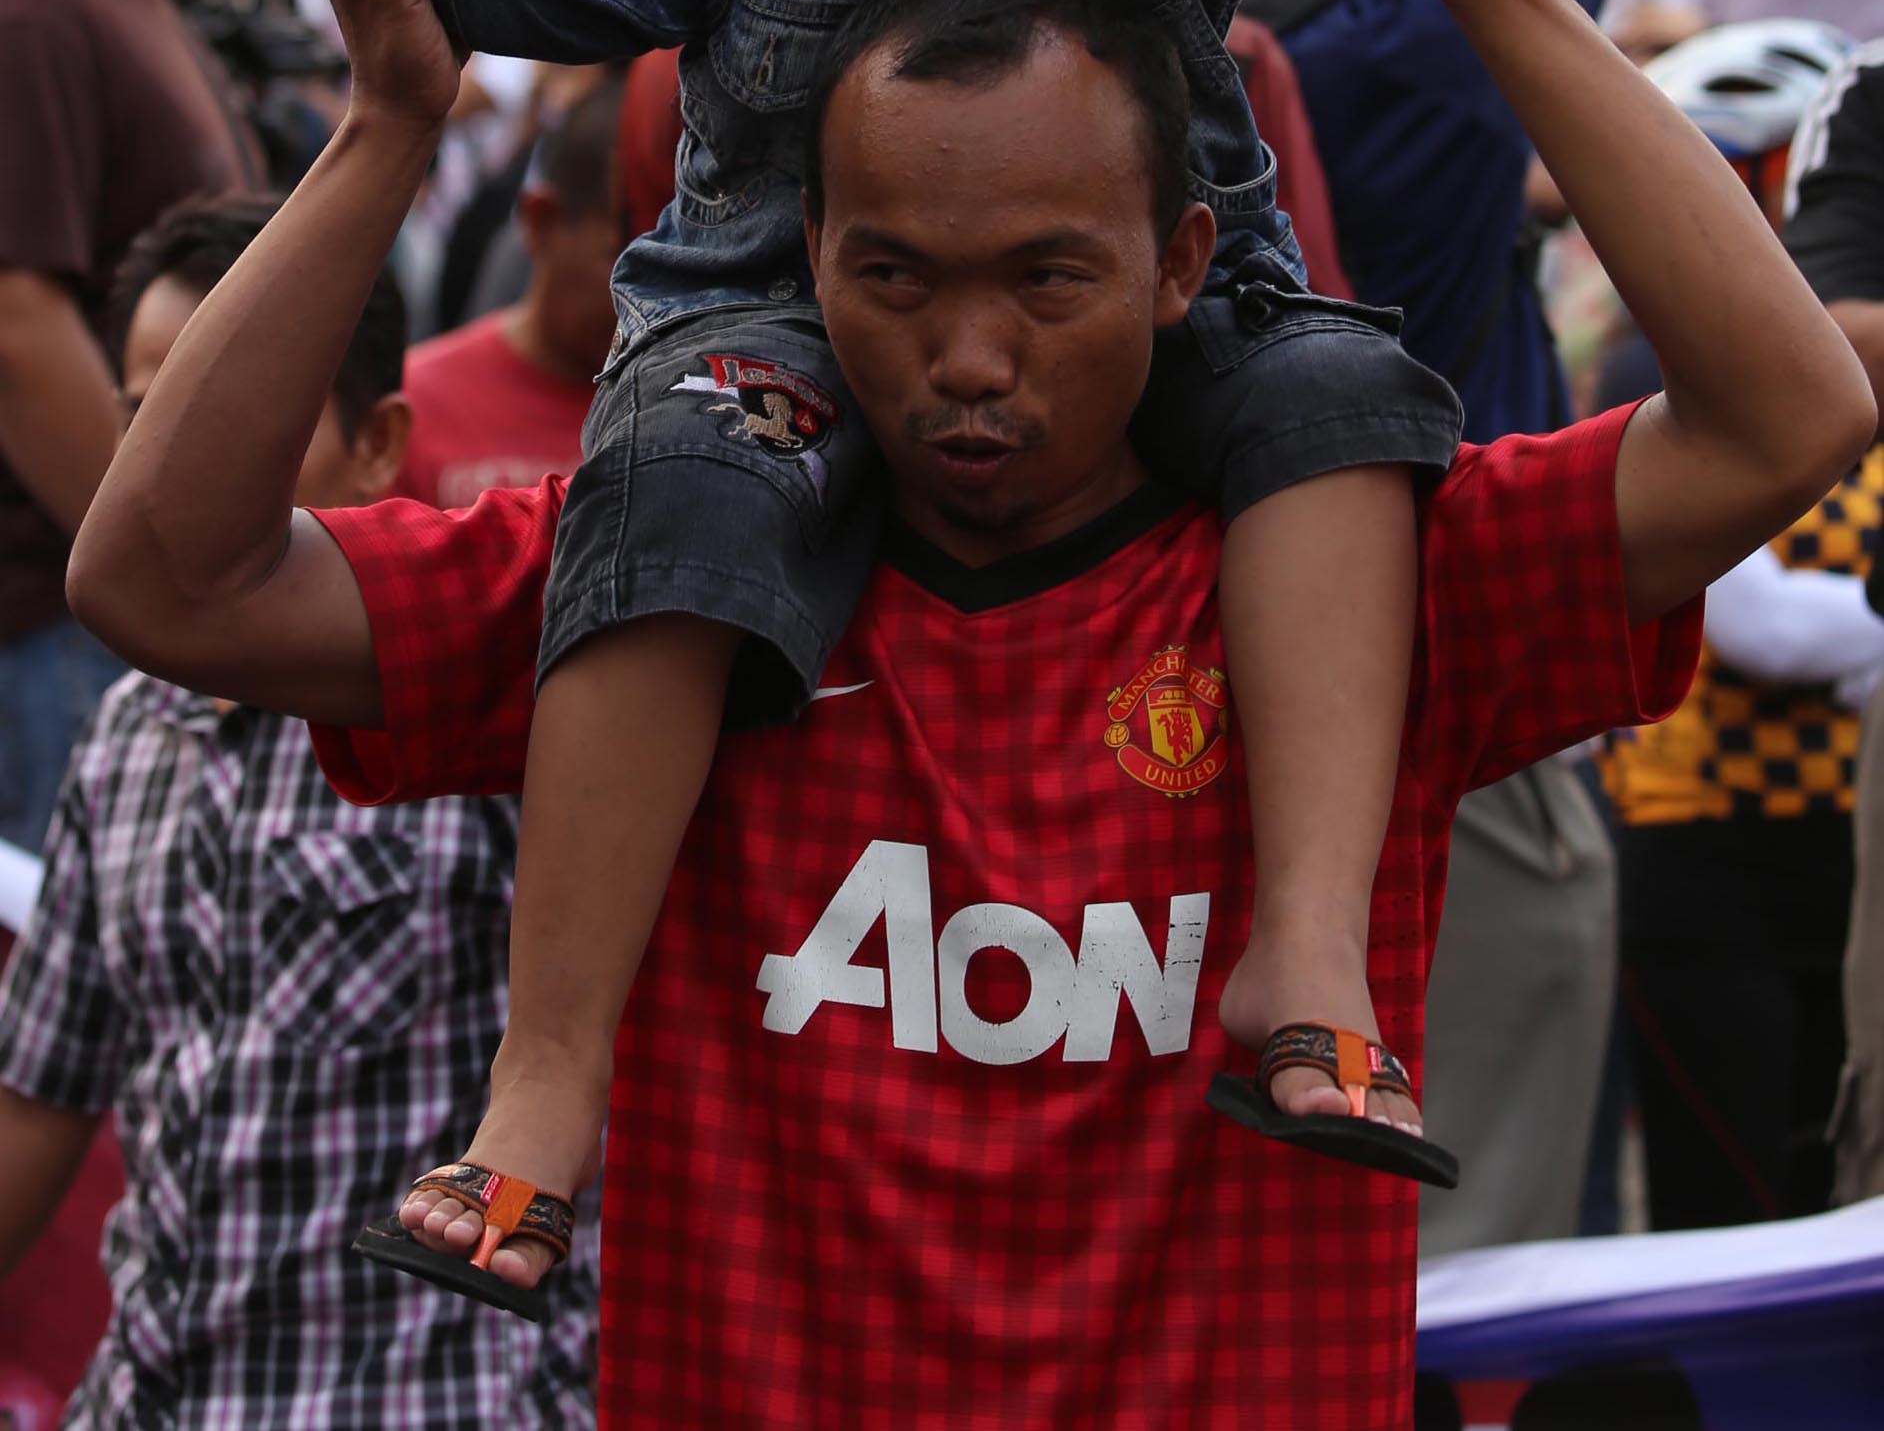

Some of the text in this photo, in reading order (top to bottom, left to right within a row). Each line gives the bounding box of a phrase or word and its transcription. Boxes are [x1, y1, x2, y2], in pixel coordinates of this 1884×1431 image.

[1118, 655, 1221, 711] MANCHTER
[1145, 758, 1217, 787] UNITED
[756, 839, 1210, 1065] AON
